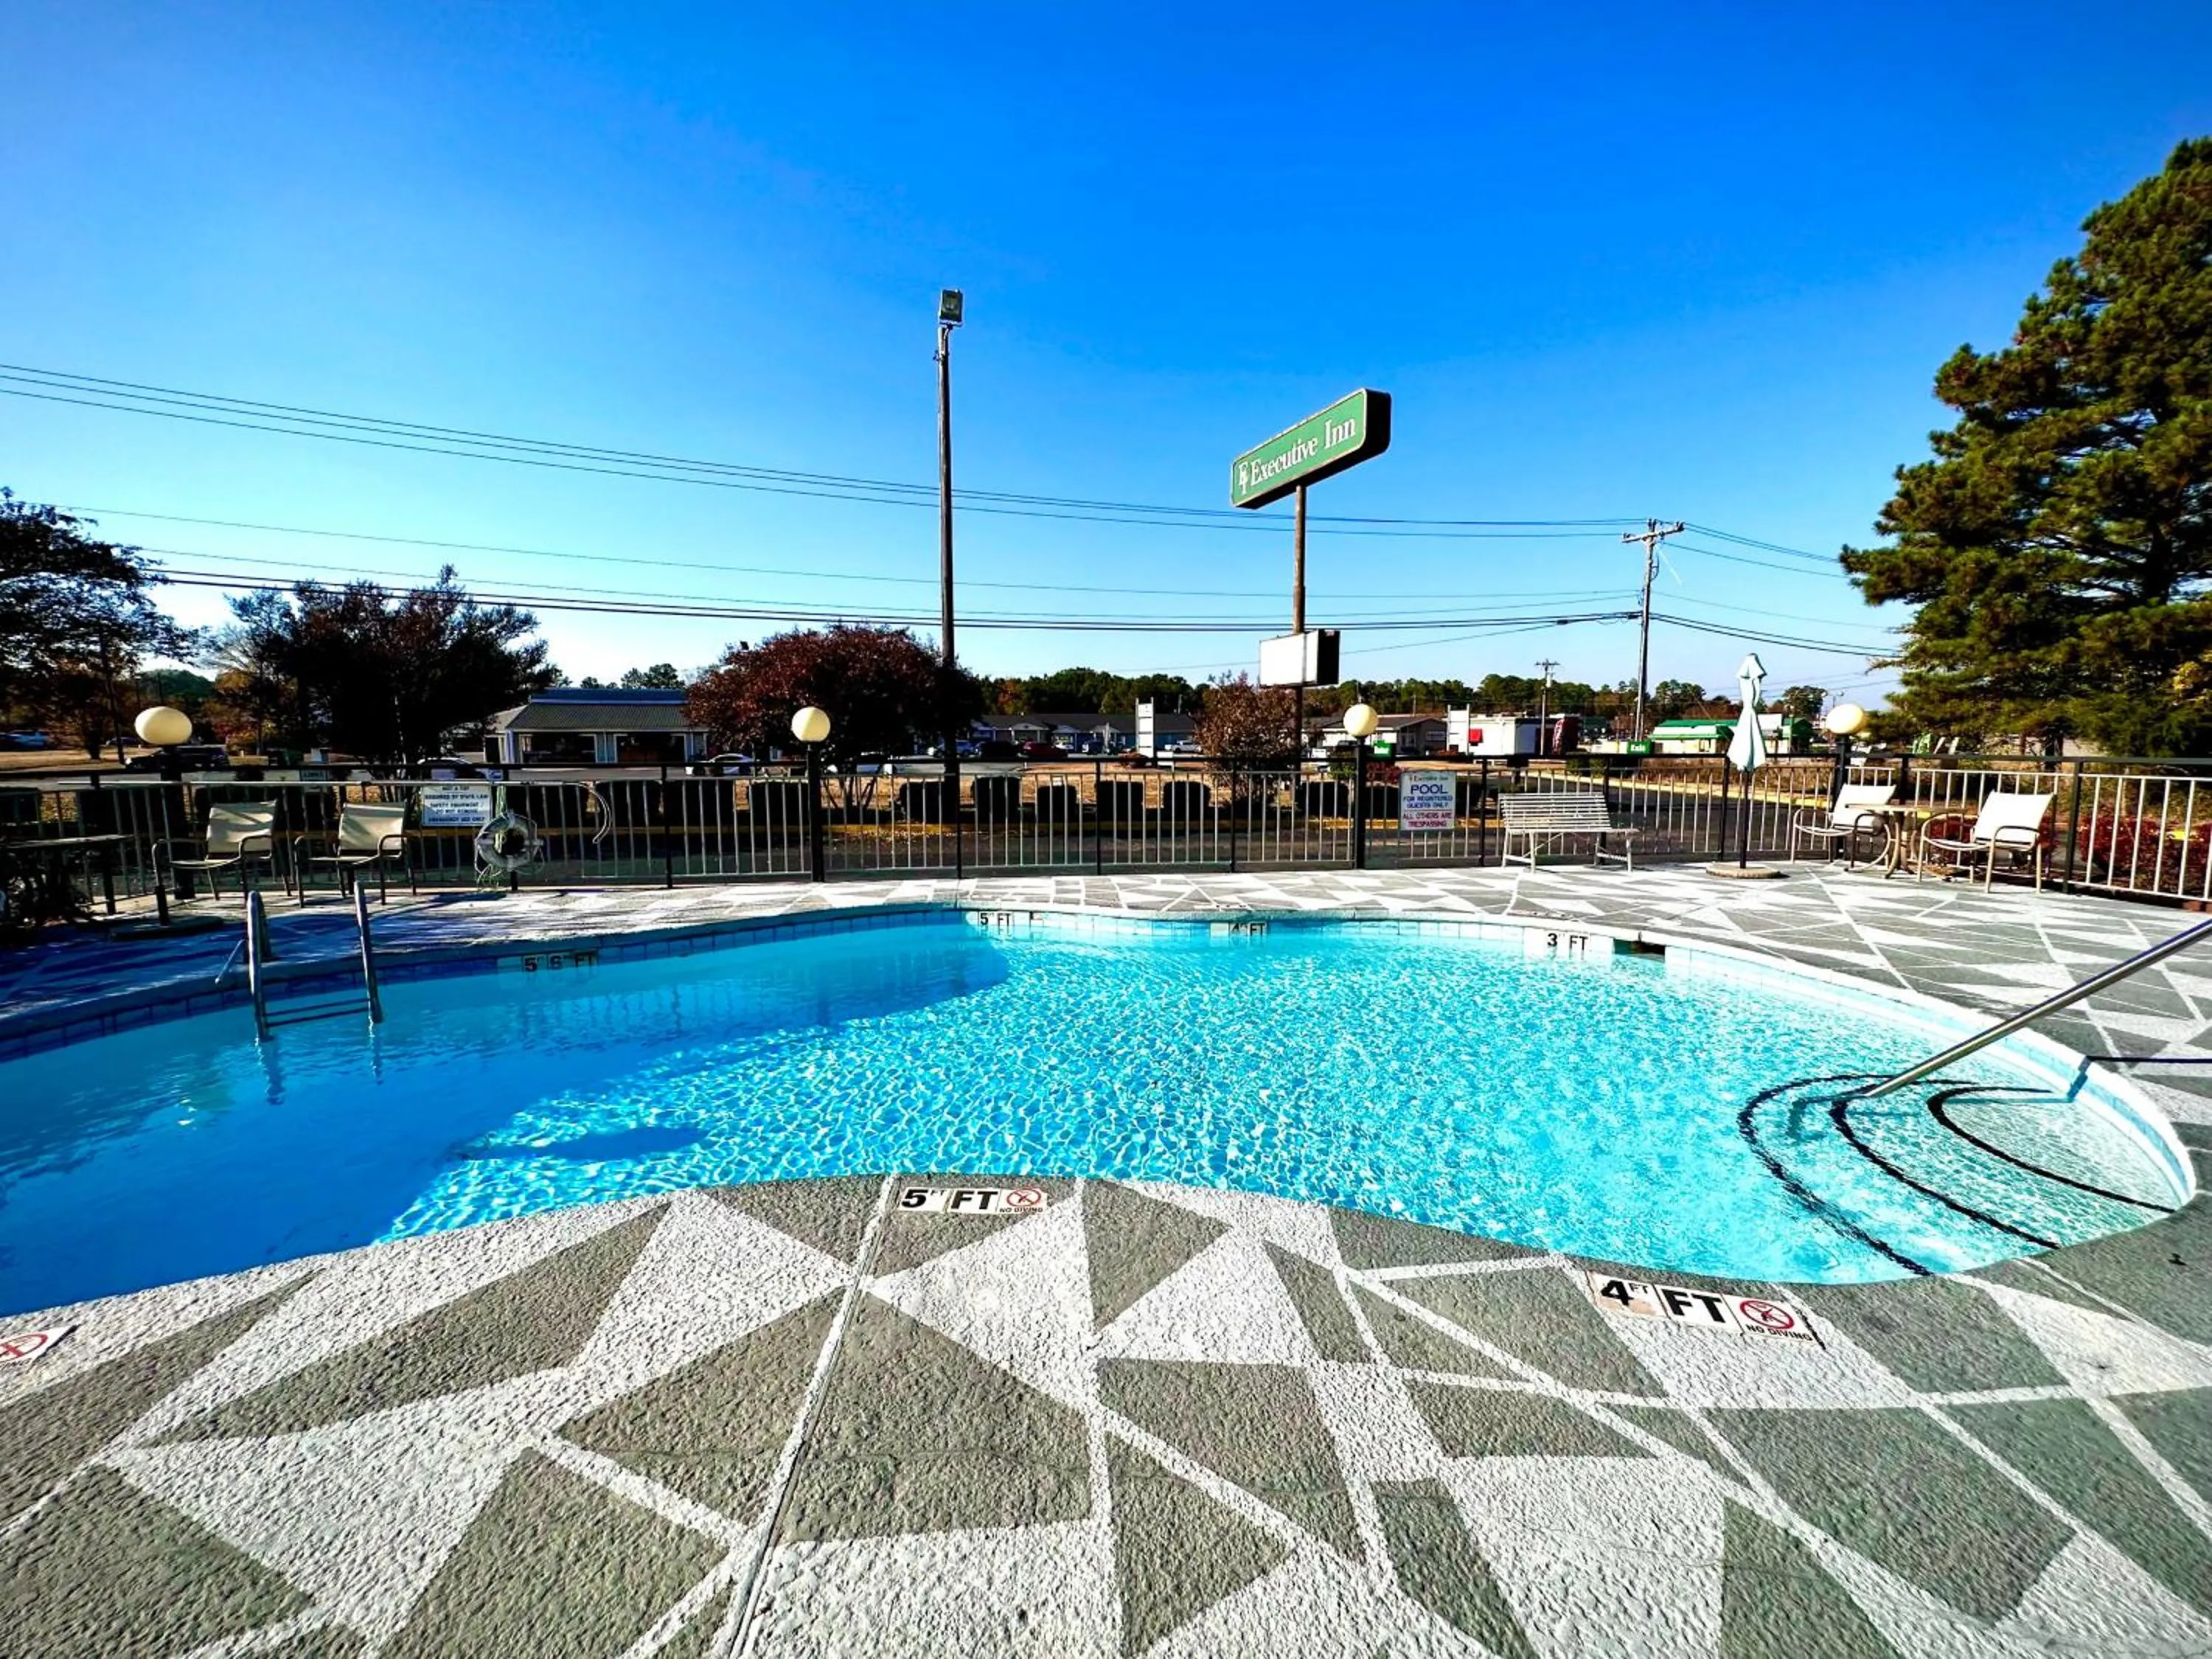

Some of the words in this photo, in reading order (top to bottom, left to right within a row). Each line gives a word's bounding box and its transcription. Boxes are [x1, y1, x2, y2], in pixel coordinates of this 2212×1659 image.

[1250, 437, 1318, 487] Executive
[1324, 417, 1356, 450] Inn
[1411, 784, 1449, 795] POOL
[997, 912, 1011, 927] FT
[1249, 922, 1266, 936] FT
[1569, 935, 1589, 950] FT
[950, 1190, 998, 1210] FT
[1660, 1288, 1726, 1324] FT
[1745, 1324, 1765, 1333] NO
[1767, 1328, 1813, 1341] DIVING
